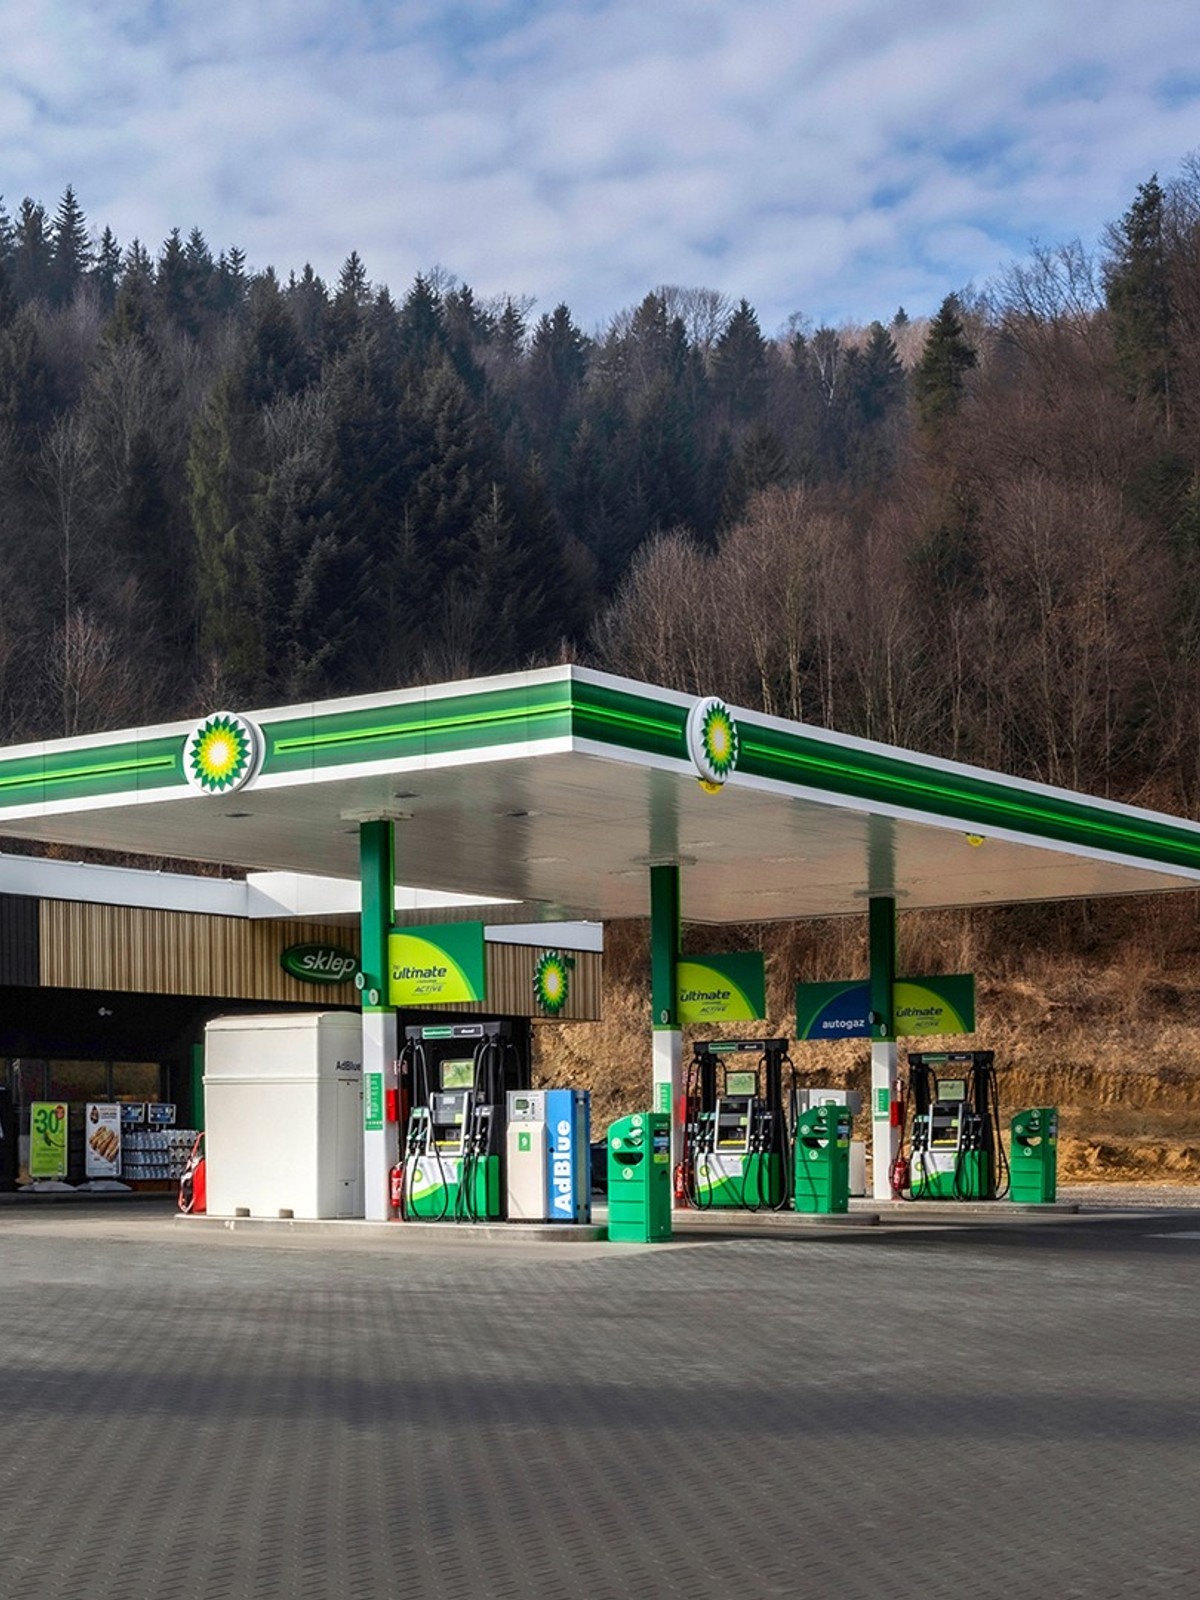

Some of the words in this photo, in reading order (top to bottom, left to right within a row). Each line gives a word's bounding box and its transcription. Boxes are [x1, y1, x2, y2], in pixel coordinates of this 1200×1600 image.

[302, 950, 356, 979] sklep
[393, 966, 447, 980] ultimate
[415, 984, 443, 993] ACTIVE
[680, 989, 731, 1002] ultimate
[896, 1006, 943, 1018] ultimate
[822, 1019, 865, 1031] autogaz
[335, 1061, 361, 1071] AdBlue
[553, 1120, 572, 1213] AdBlue
